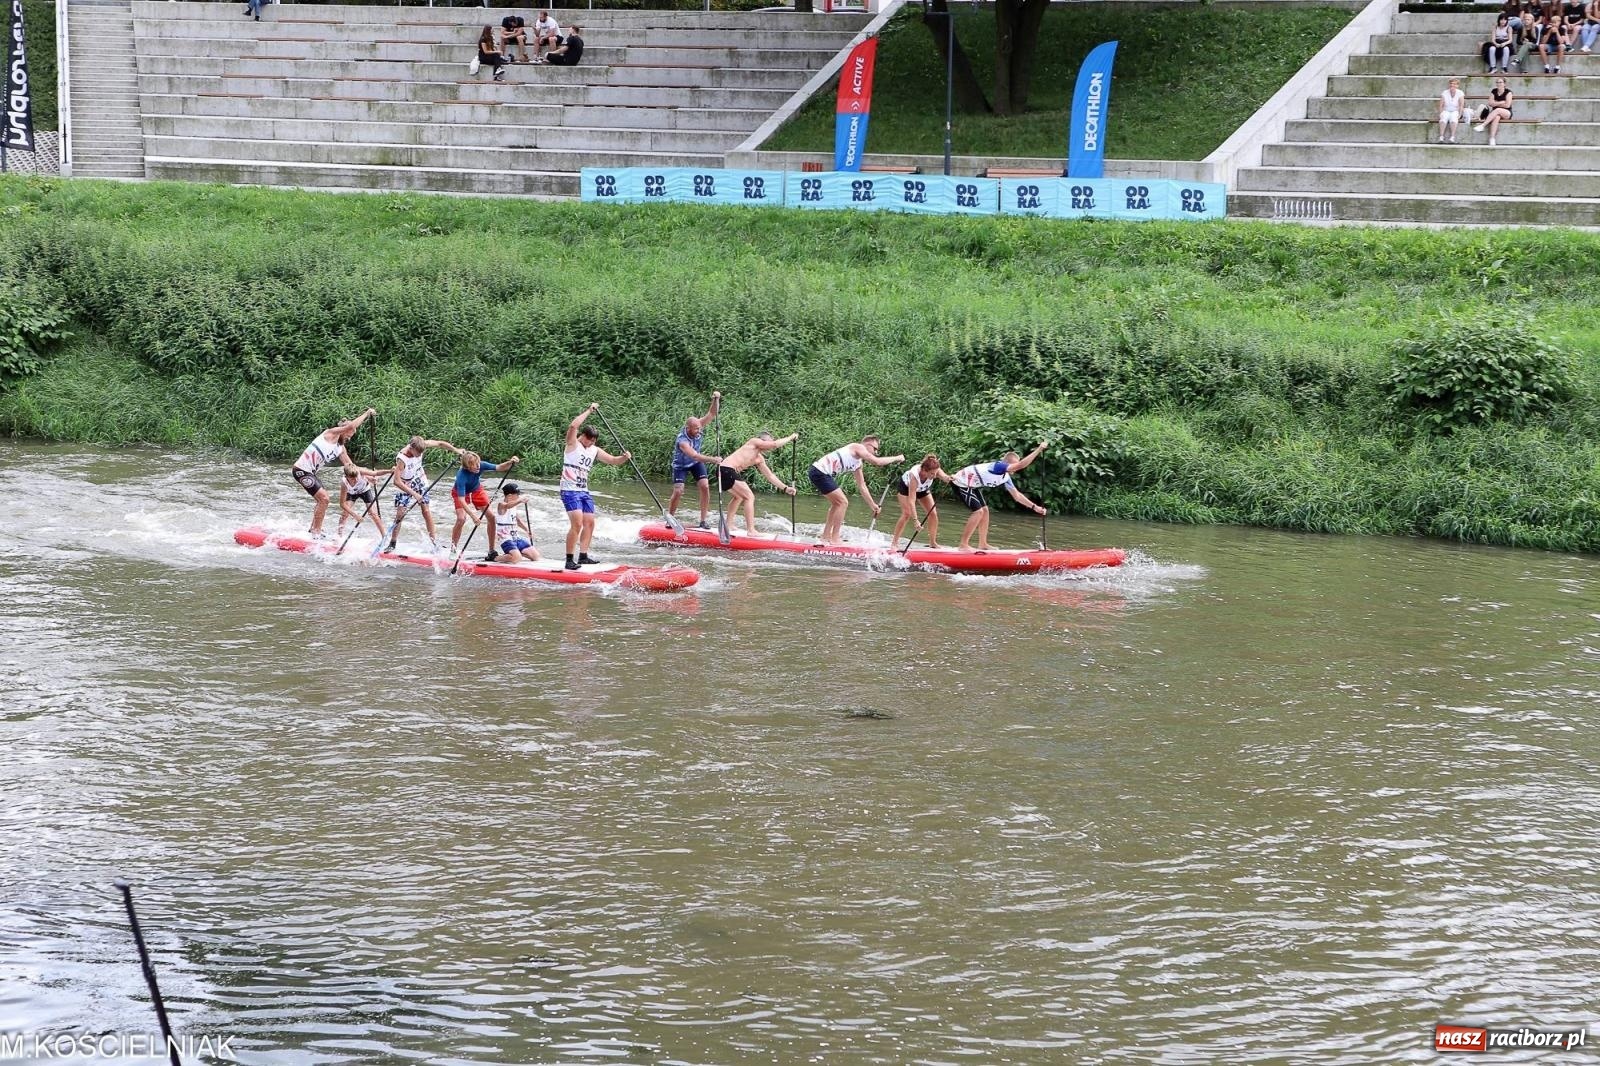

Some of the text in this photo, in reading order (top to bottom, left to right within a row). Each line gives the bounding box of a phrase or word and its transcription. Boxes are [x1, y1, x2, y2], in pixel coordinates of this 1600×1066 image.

[845, 56, 865, 166] DECATHLON ACTIVE
[1084, 72, 1104, 151] DECATHLON
[595, 175, 615, 186] OD
[644, 175, 665, 186] OD
[693, 175, 714, 186] OD
[742, 176, 764, 188] OD
[800, 178, 822, 190] OD
[851, 180, 873, 191] OD
[903, 180, 926, 192] OD
[955, 183, 978, 196] OD
[1016, 185, 1039, 197] OD
[1070, 185, 1093, 198] OD
[1125, 185, 1148, 198] OD
[1180, 188, 1204, 201] OD
[578, 454, 592, 467] 30
